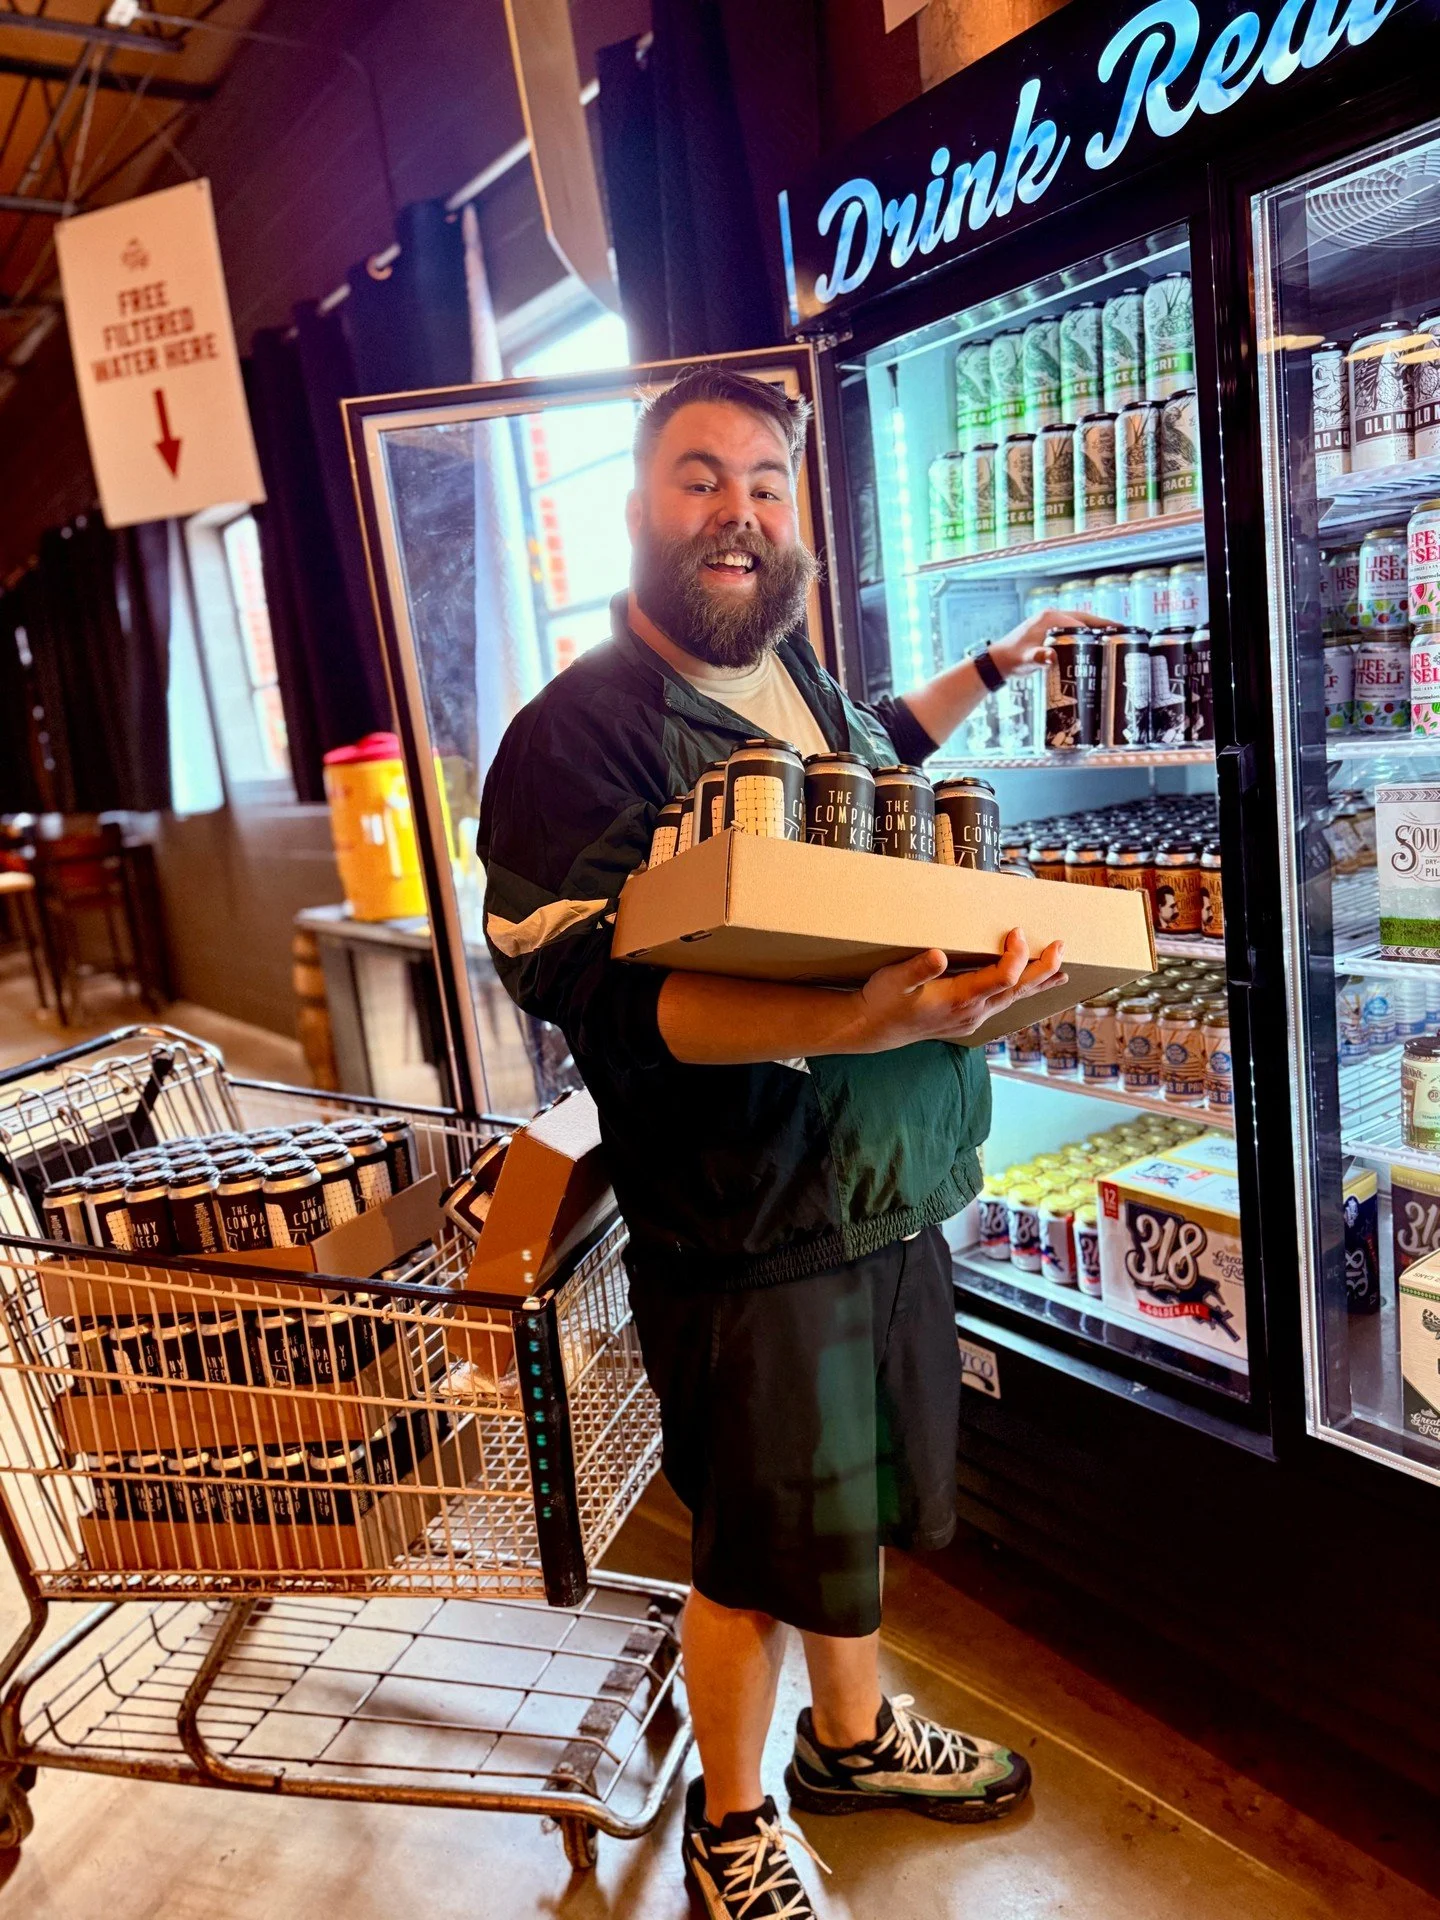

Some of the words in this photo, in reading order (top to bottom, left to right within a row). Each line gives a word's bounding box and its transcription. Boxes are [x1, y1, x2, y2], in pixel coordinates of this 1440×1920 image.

[815, 78, 1071, 304] Drink
[117, 280, 168, 317] FREE
[103, 306, 195, 351] FILTERED
[92, 347, 158, 384] WATER
[163, 332, 219, 369] HERE
[1153, 356, 1181, 373] GRIT
[1364, 415, 1392, 435] OLD
[1366, 555, 1400, 569] LIFE
[1356, 659, 1385, 672] LIFE
[1355, 671, 1405, 685] ITSELF
[829, 790, 852, 805] THE
[886, 800, 909, 813] THE
[975, 812, 994, 828] THE
[301, 1197, 317, 1210] THE
[1103, 1188, 1117, 1204] 12
[231, 1205, 249, 1216] THE
[1126, 1213, 1206, 1291] 318
